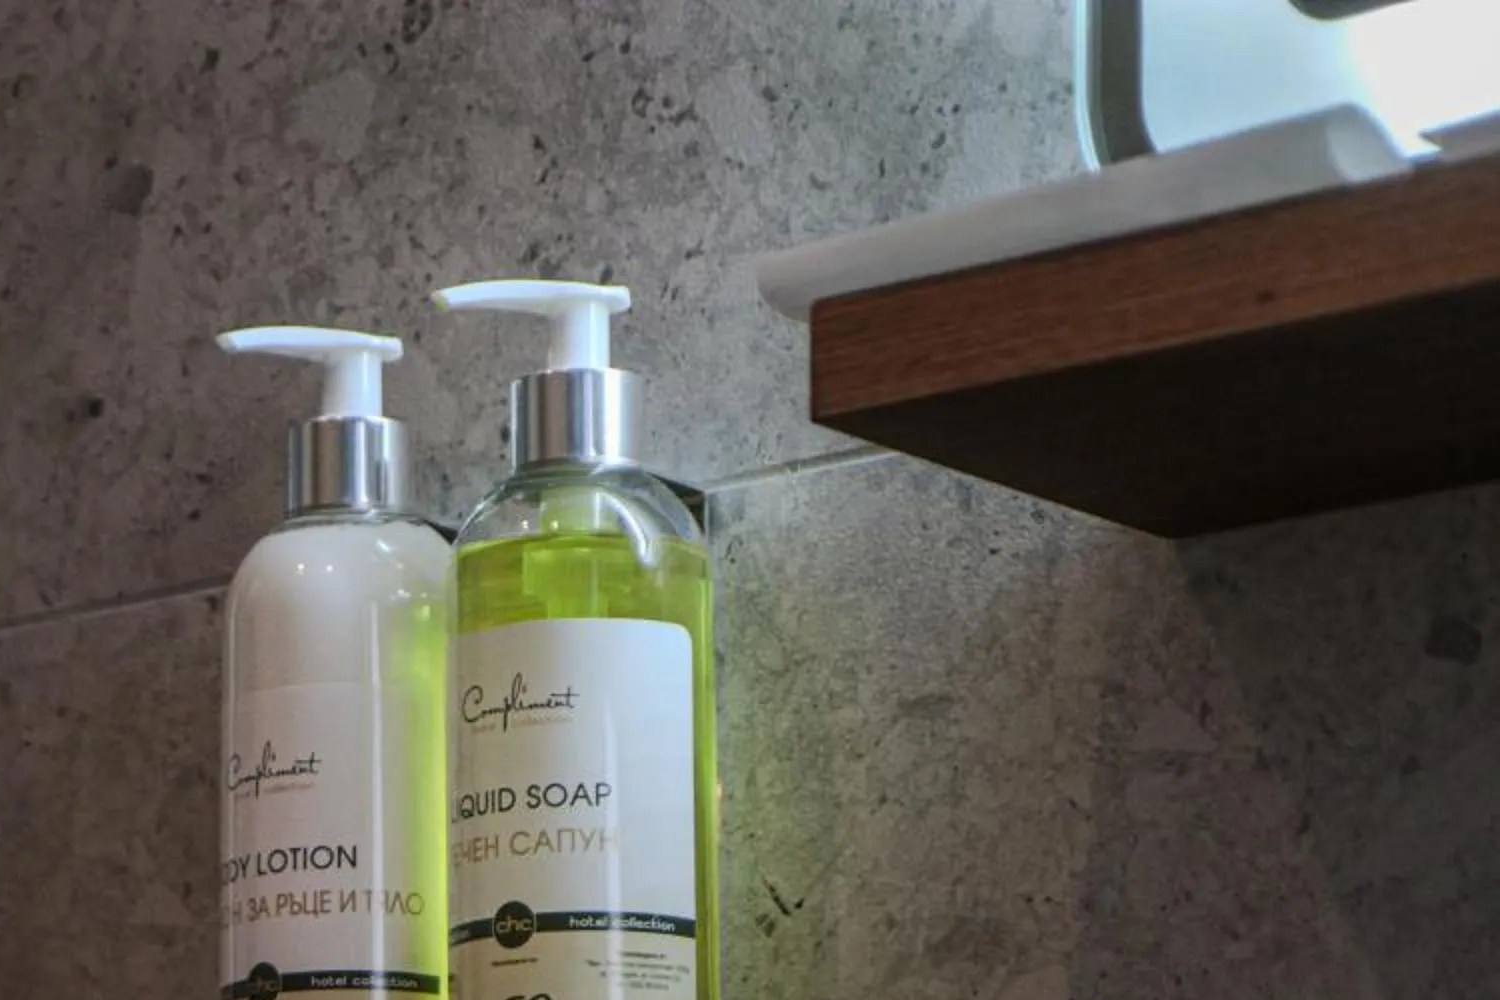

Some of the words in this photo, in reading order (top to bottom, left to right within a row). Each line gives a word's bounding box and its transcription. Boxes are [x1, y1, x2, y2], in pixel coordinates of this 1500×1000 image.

[462, 671, 581, 733] Compliment
[526, 782, 613, 809] SOAP
[257, 845, 357, 876] LOTION
[339, 887, 357, 914] И
[311, 975, 348, 988] hotel
